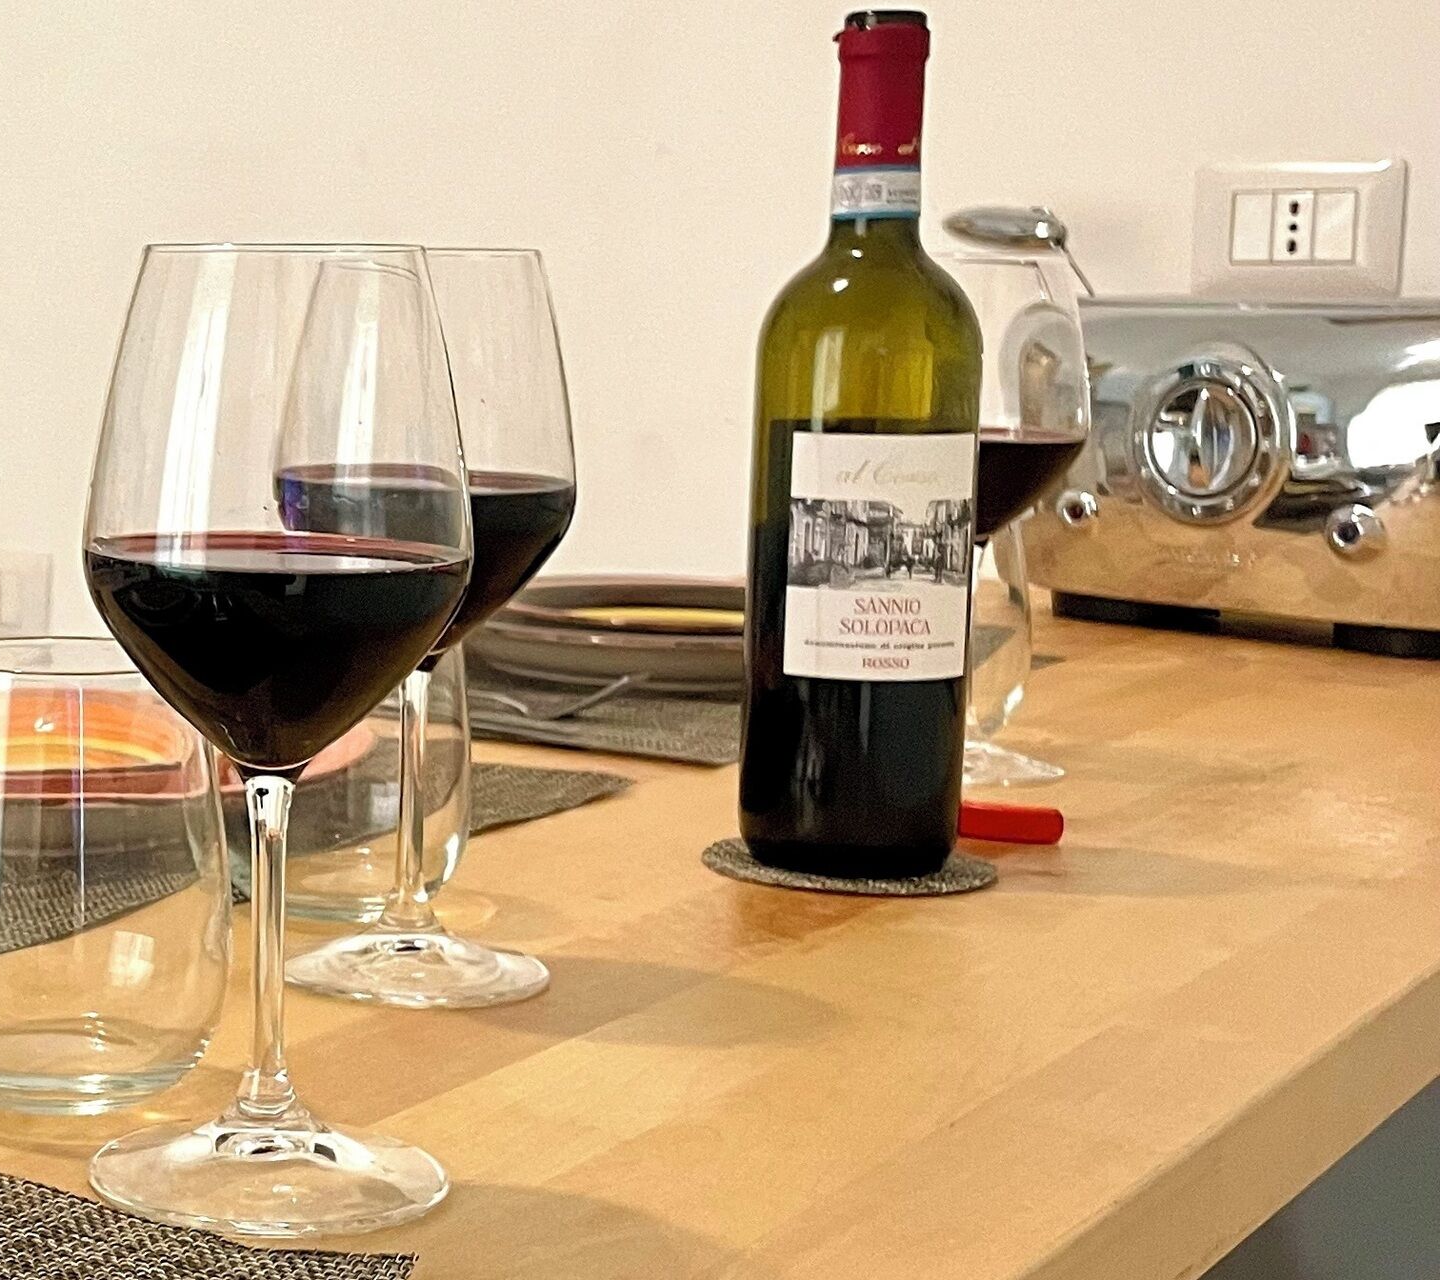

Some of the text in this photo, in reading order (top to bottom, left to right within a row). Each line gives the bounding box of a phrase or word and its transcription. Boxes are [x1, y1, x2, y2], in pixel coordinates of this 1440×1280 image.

[854, 598, 921, 615] SANNIO
[839, 617, 931, 636] SOLOPACA
[862, 657, 910, 669] ROSSO
